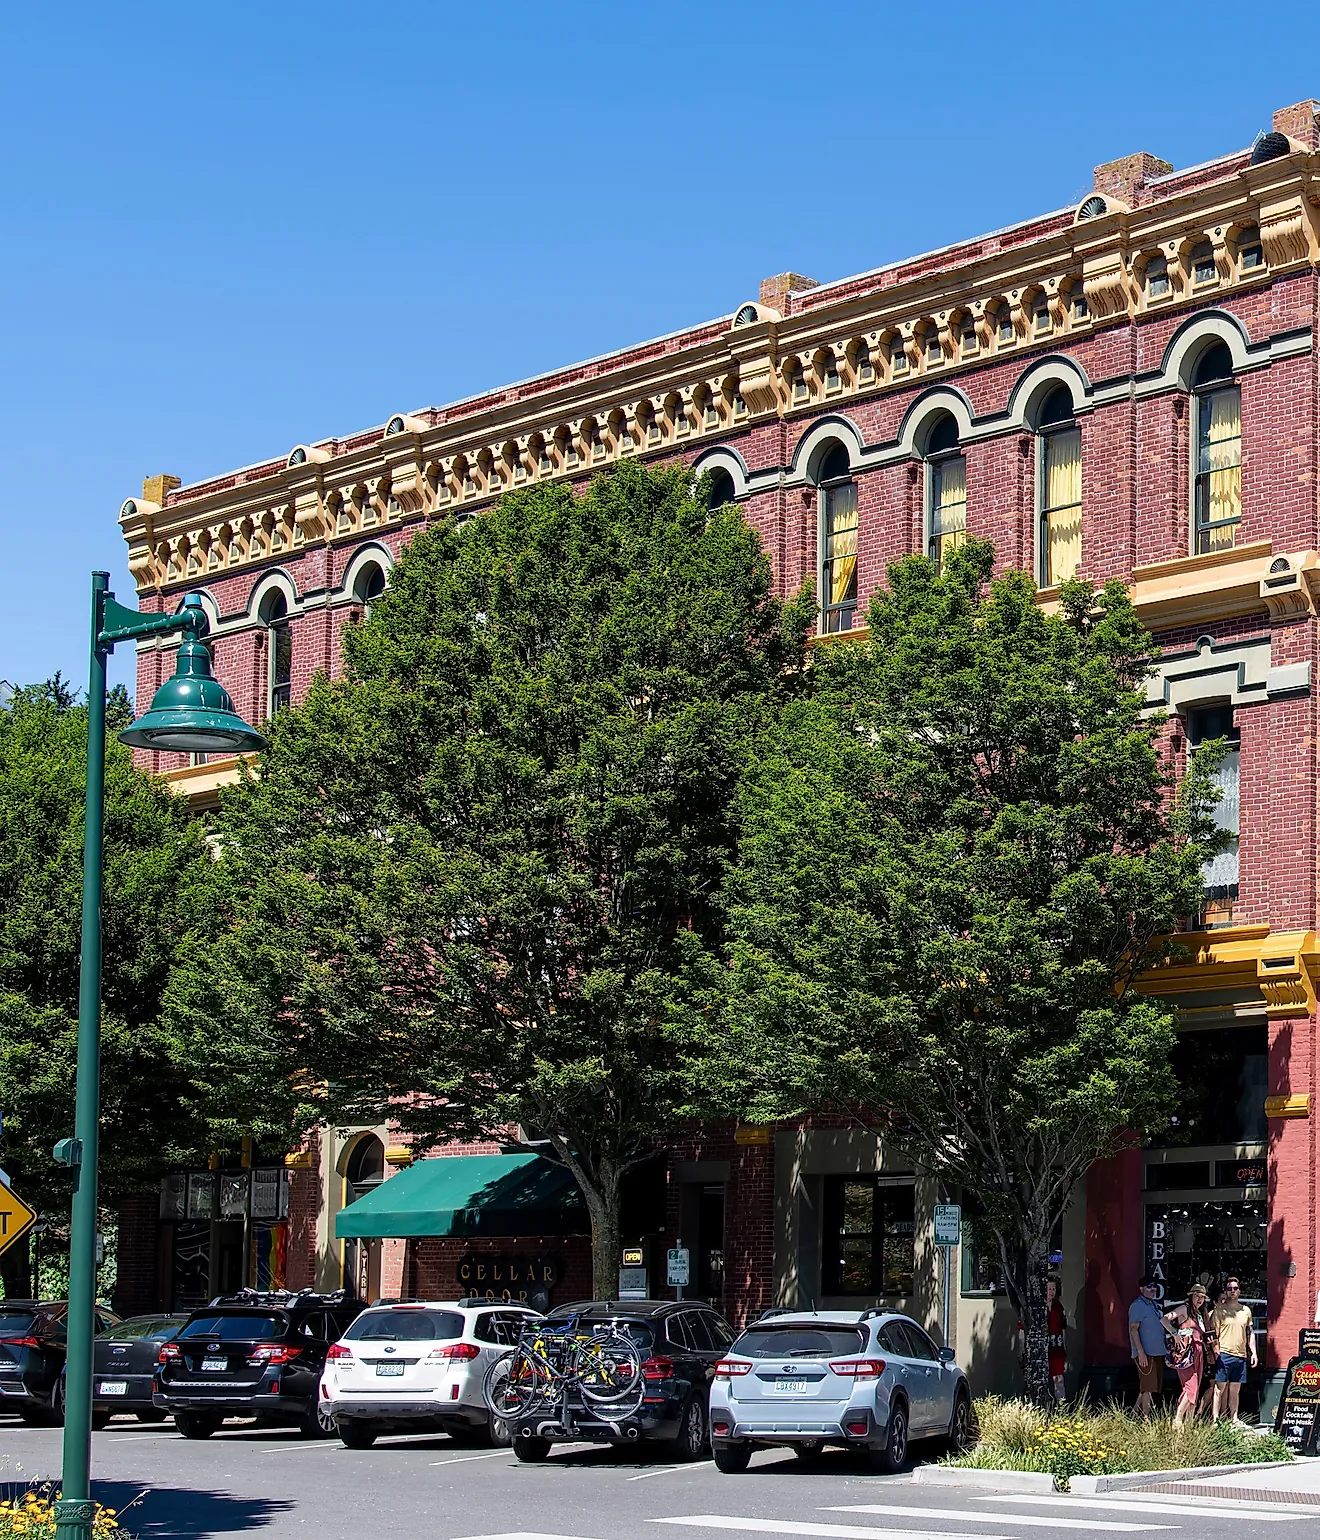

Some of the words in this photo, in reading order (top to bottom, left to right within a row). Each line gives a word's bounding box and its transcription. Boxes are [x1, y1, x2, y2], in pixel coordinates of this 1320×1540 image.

[1237, 1168, 1264, 1180] OPEN
[937, 1206, 945, 1216] 15
[625, 1252, 641, 1261] OPEN
[460, 1264, 553, 1282] CELLAR
[1297, 1378, 1318, 1387] DOOR
[1286, 1411, 1313, 1419] Cocktails
